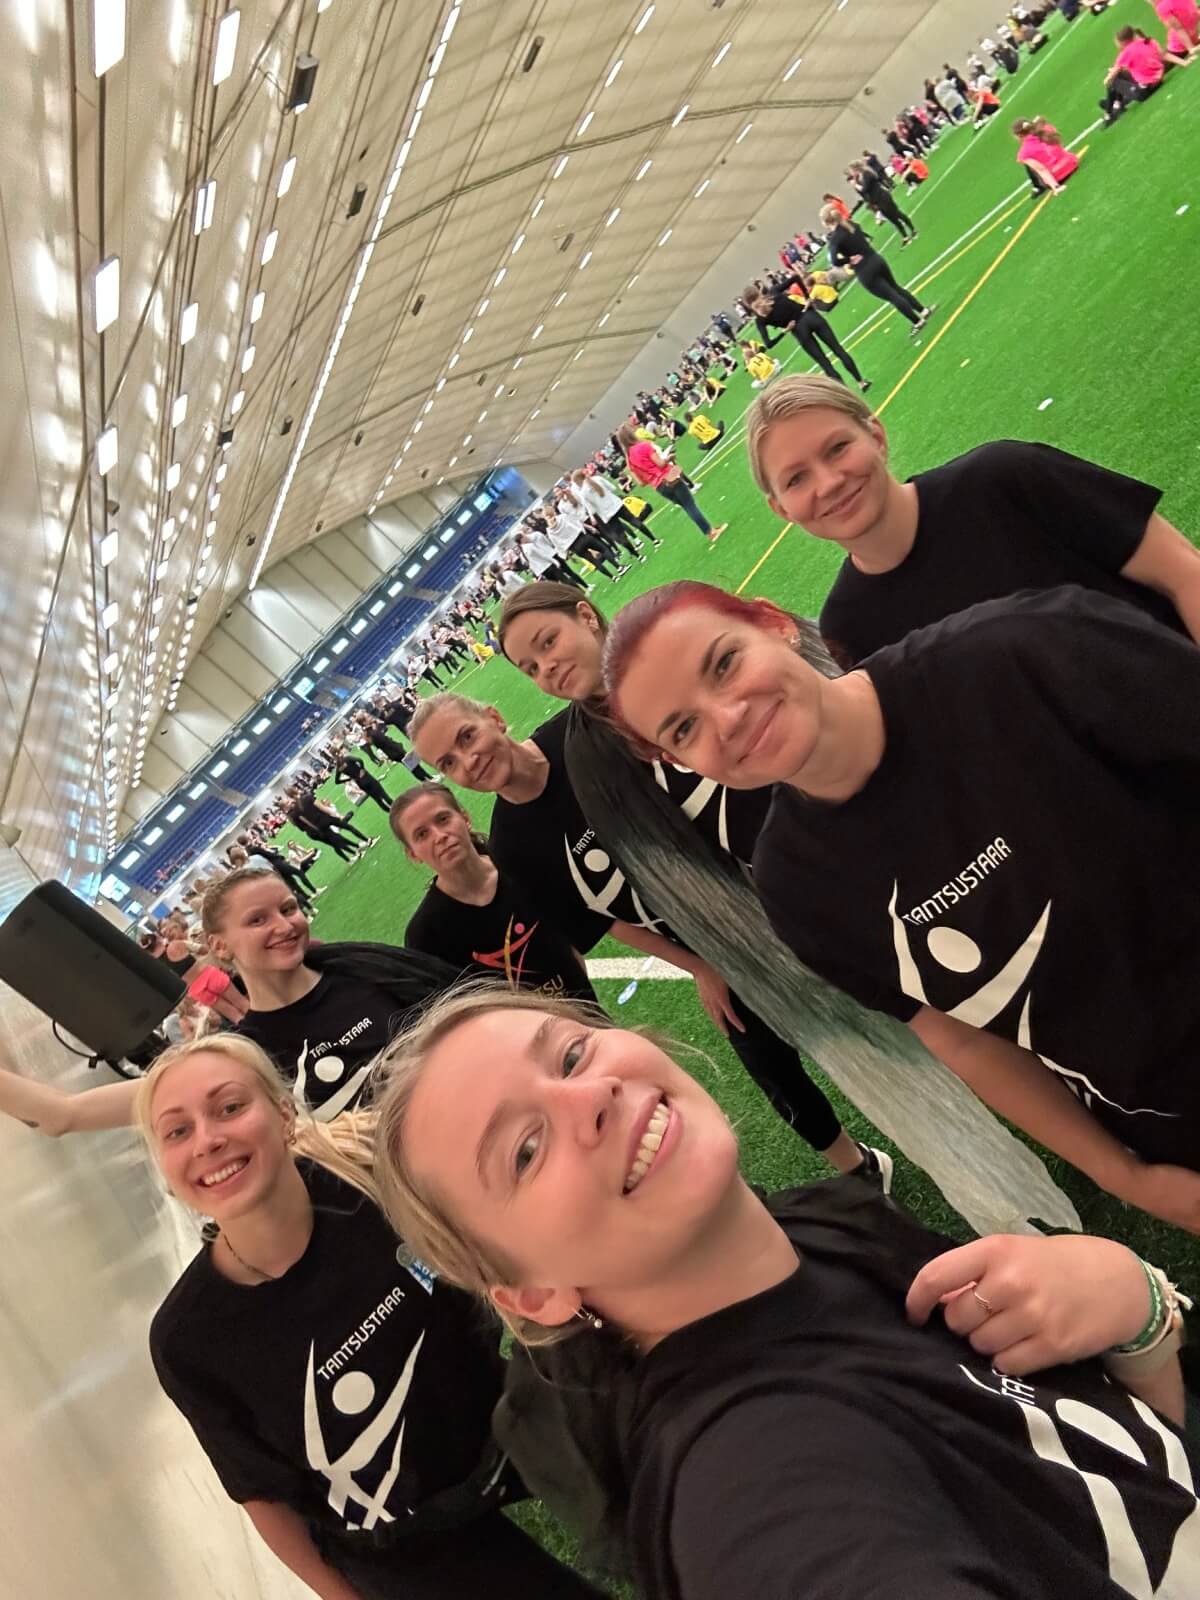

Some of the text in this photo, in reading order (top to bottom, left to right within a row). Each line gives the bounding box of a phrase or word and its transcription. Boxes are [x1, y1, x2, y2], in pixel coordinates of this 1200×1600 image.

[571, 828, 596, 855] TANTS
[901, 836, 1013, 926] TANTSUSTAAR
[316, 1286, 405, 1380] TANTSUSTAAR
